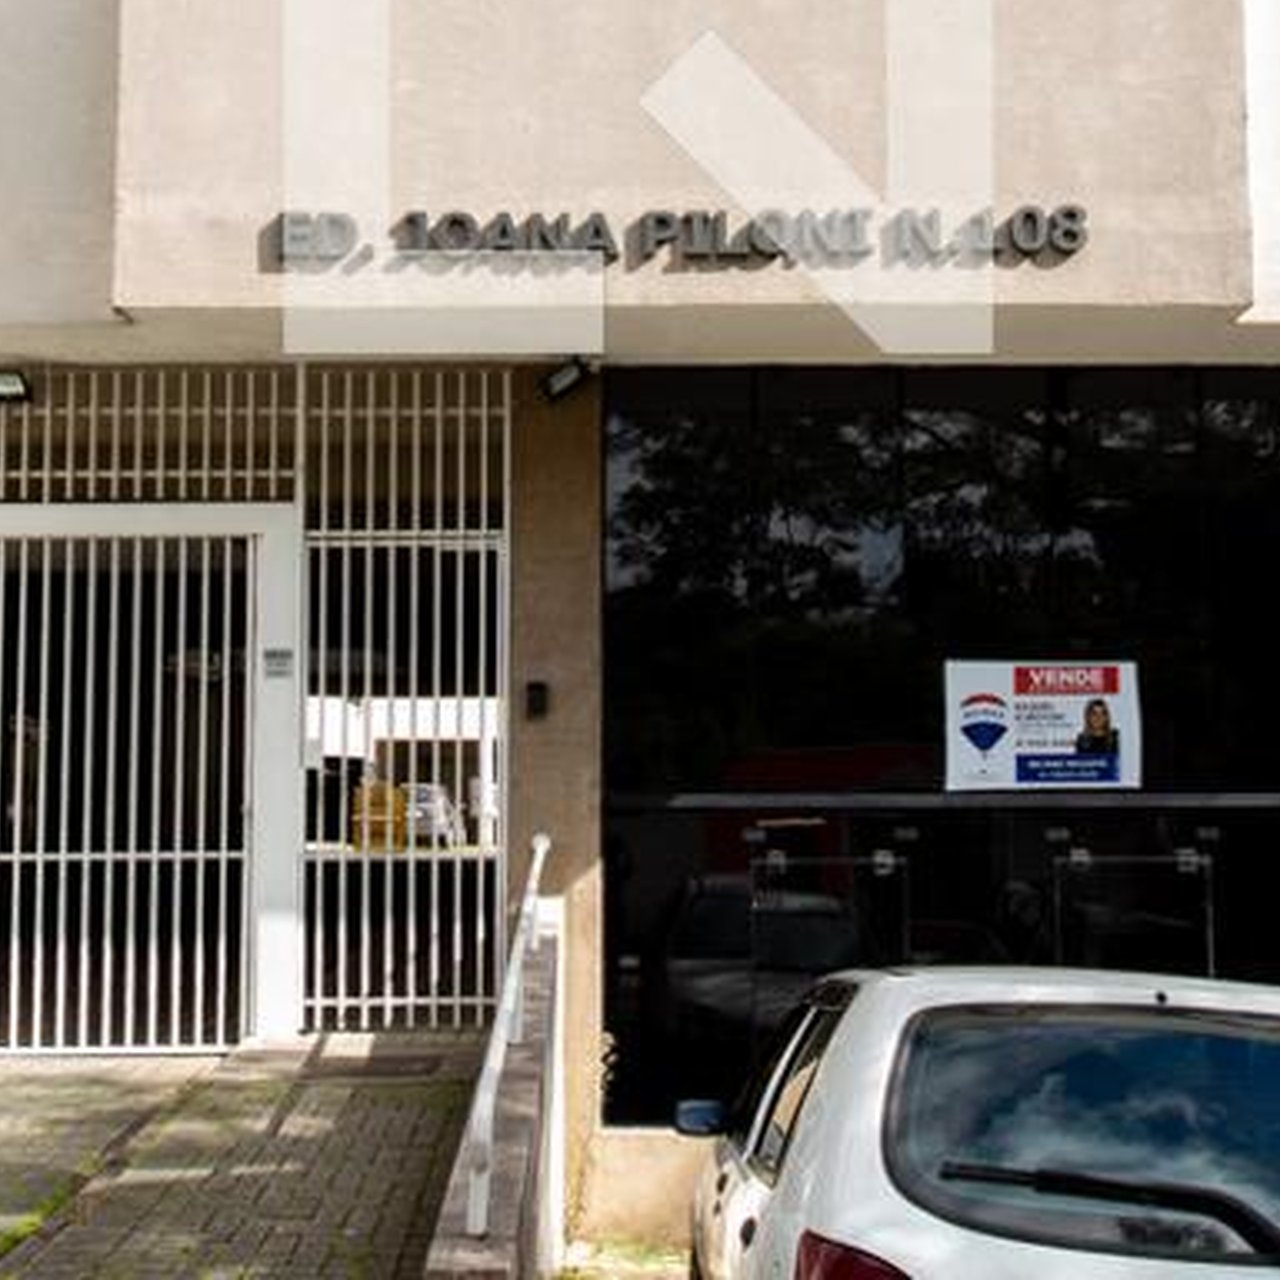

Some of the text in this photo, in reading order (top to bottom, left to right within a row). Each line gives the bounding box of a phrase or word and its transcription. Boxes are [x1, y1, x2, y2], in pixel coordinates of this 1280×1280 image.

[392, 209, 618, 263] JOANA
[637, 209, 872, 263] PILONI
[1028, 667, 1105, 687] VENDE
